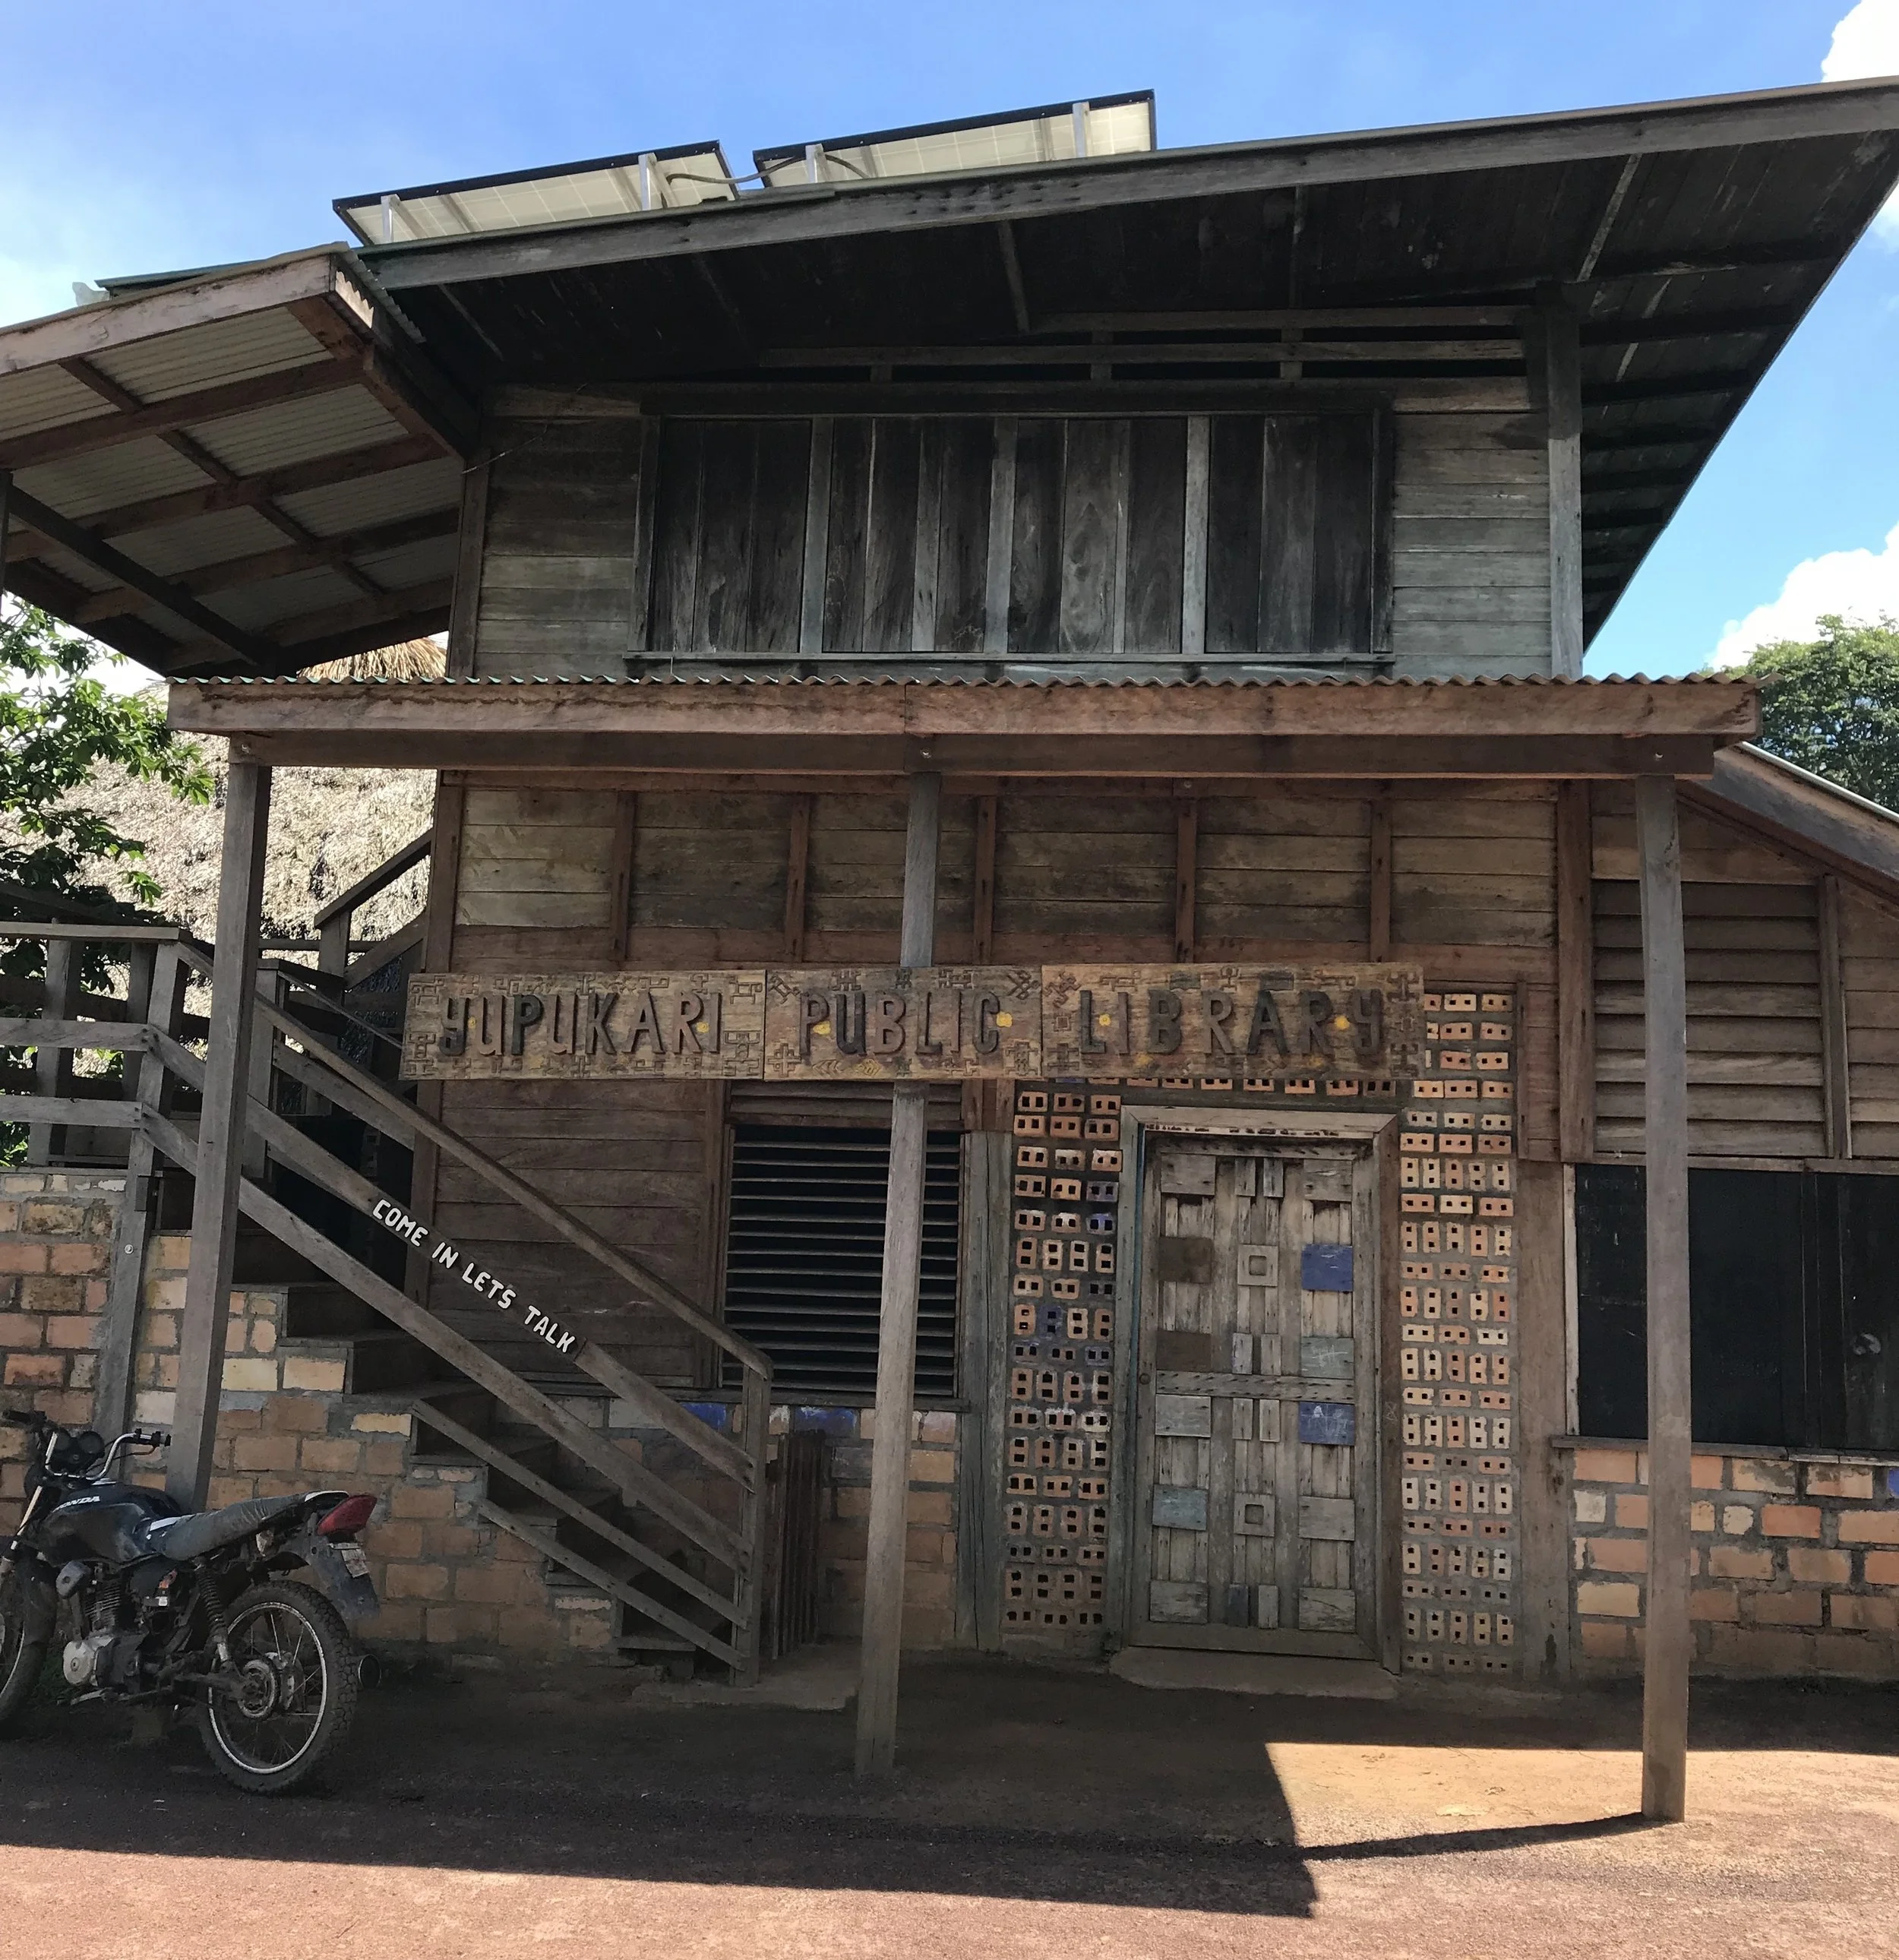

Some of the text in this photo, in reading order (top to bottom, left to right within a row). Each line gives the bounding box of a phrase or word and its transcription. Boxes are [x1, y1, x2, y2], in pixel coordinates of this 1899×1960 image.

[438, 988, 1383, 1056] YUPUKARI PUBLIC LIBRARY
[372, 1199, 428, 1247] COME
[431, 1242, 459, 1269] IN
[524, 1305, 575, 1353] TALK
